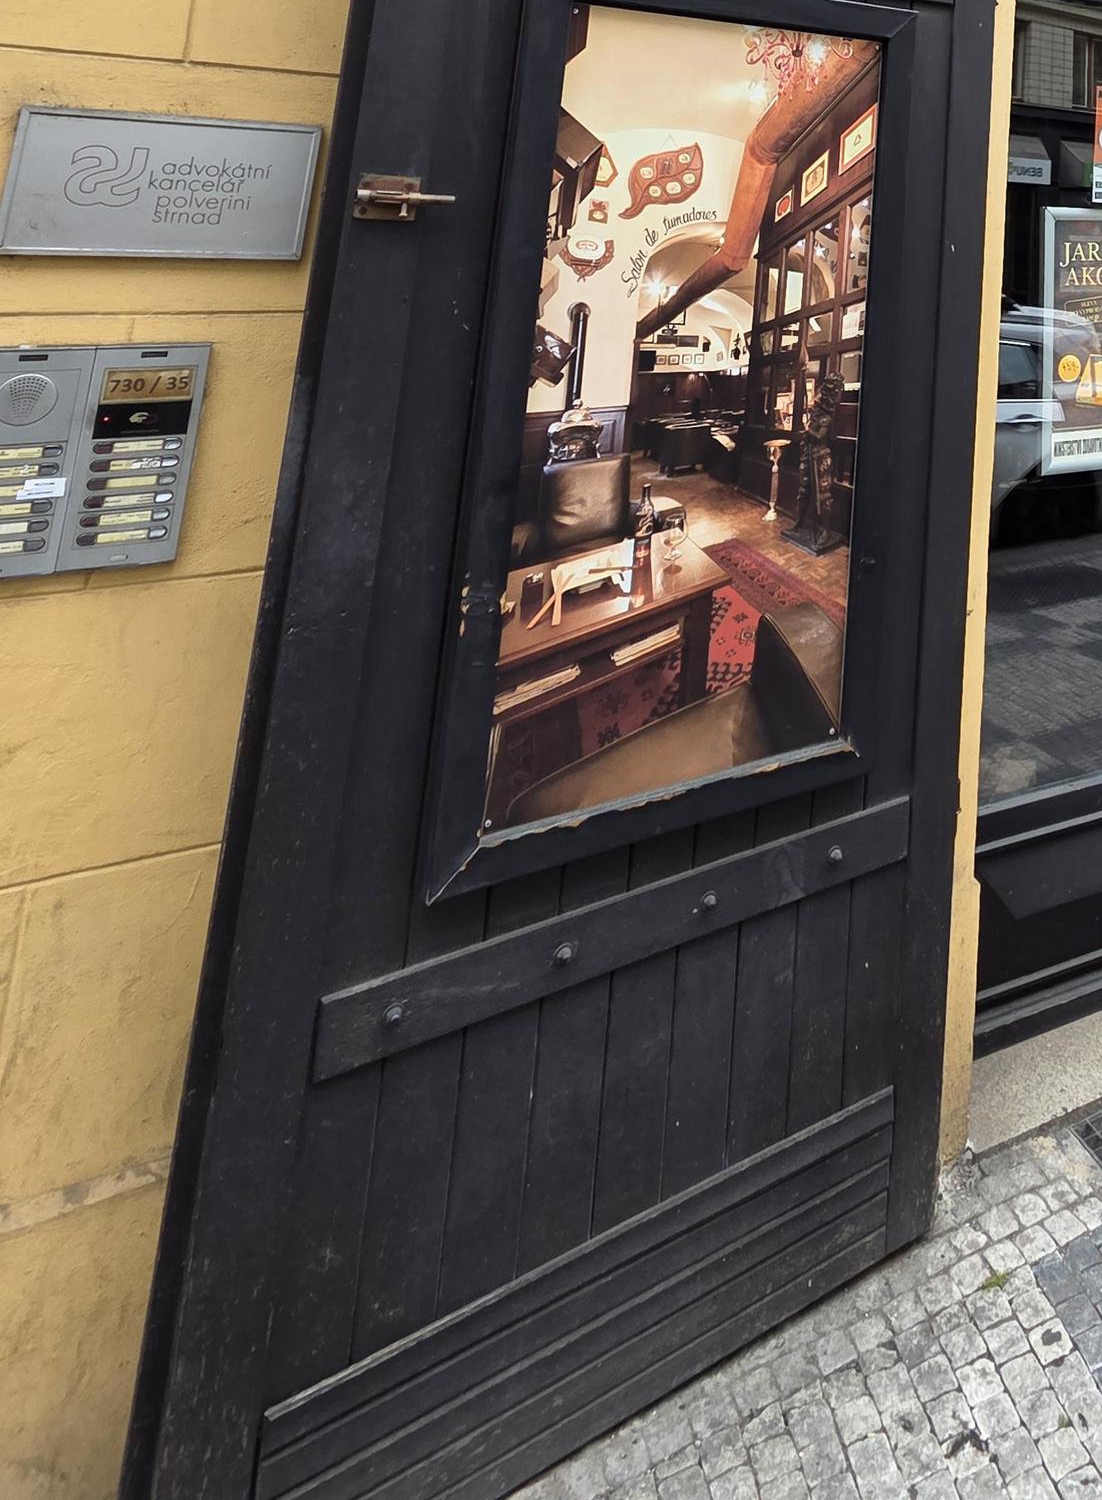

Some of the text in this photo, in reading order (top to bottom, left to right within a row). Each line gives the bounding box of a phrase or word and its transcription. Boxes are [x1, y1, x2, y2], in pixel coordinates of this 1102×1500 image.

[161, 156, 273, 180] advokátní
[148, 170, 246, 194] kancelář
[155, 191, 252, 214] polverini
[152, 206, 221, 226] strnad
[644, 227, 659, 247] de
[109, 375, 189, 395] 730 / 35
